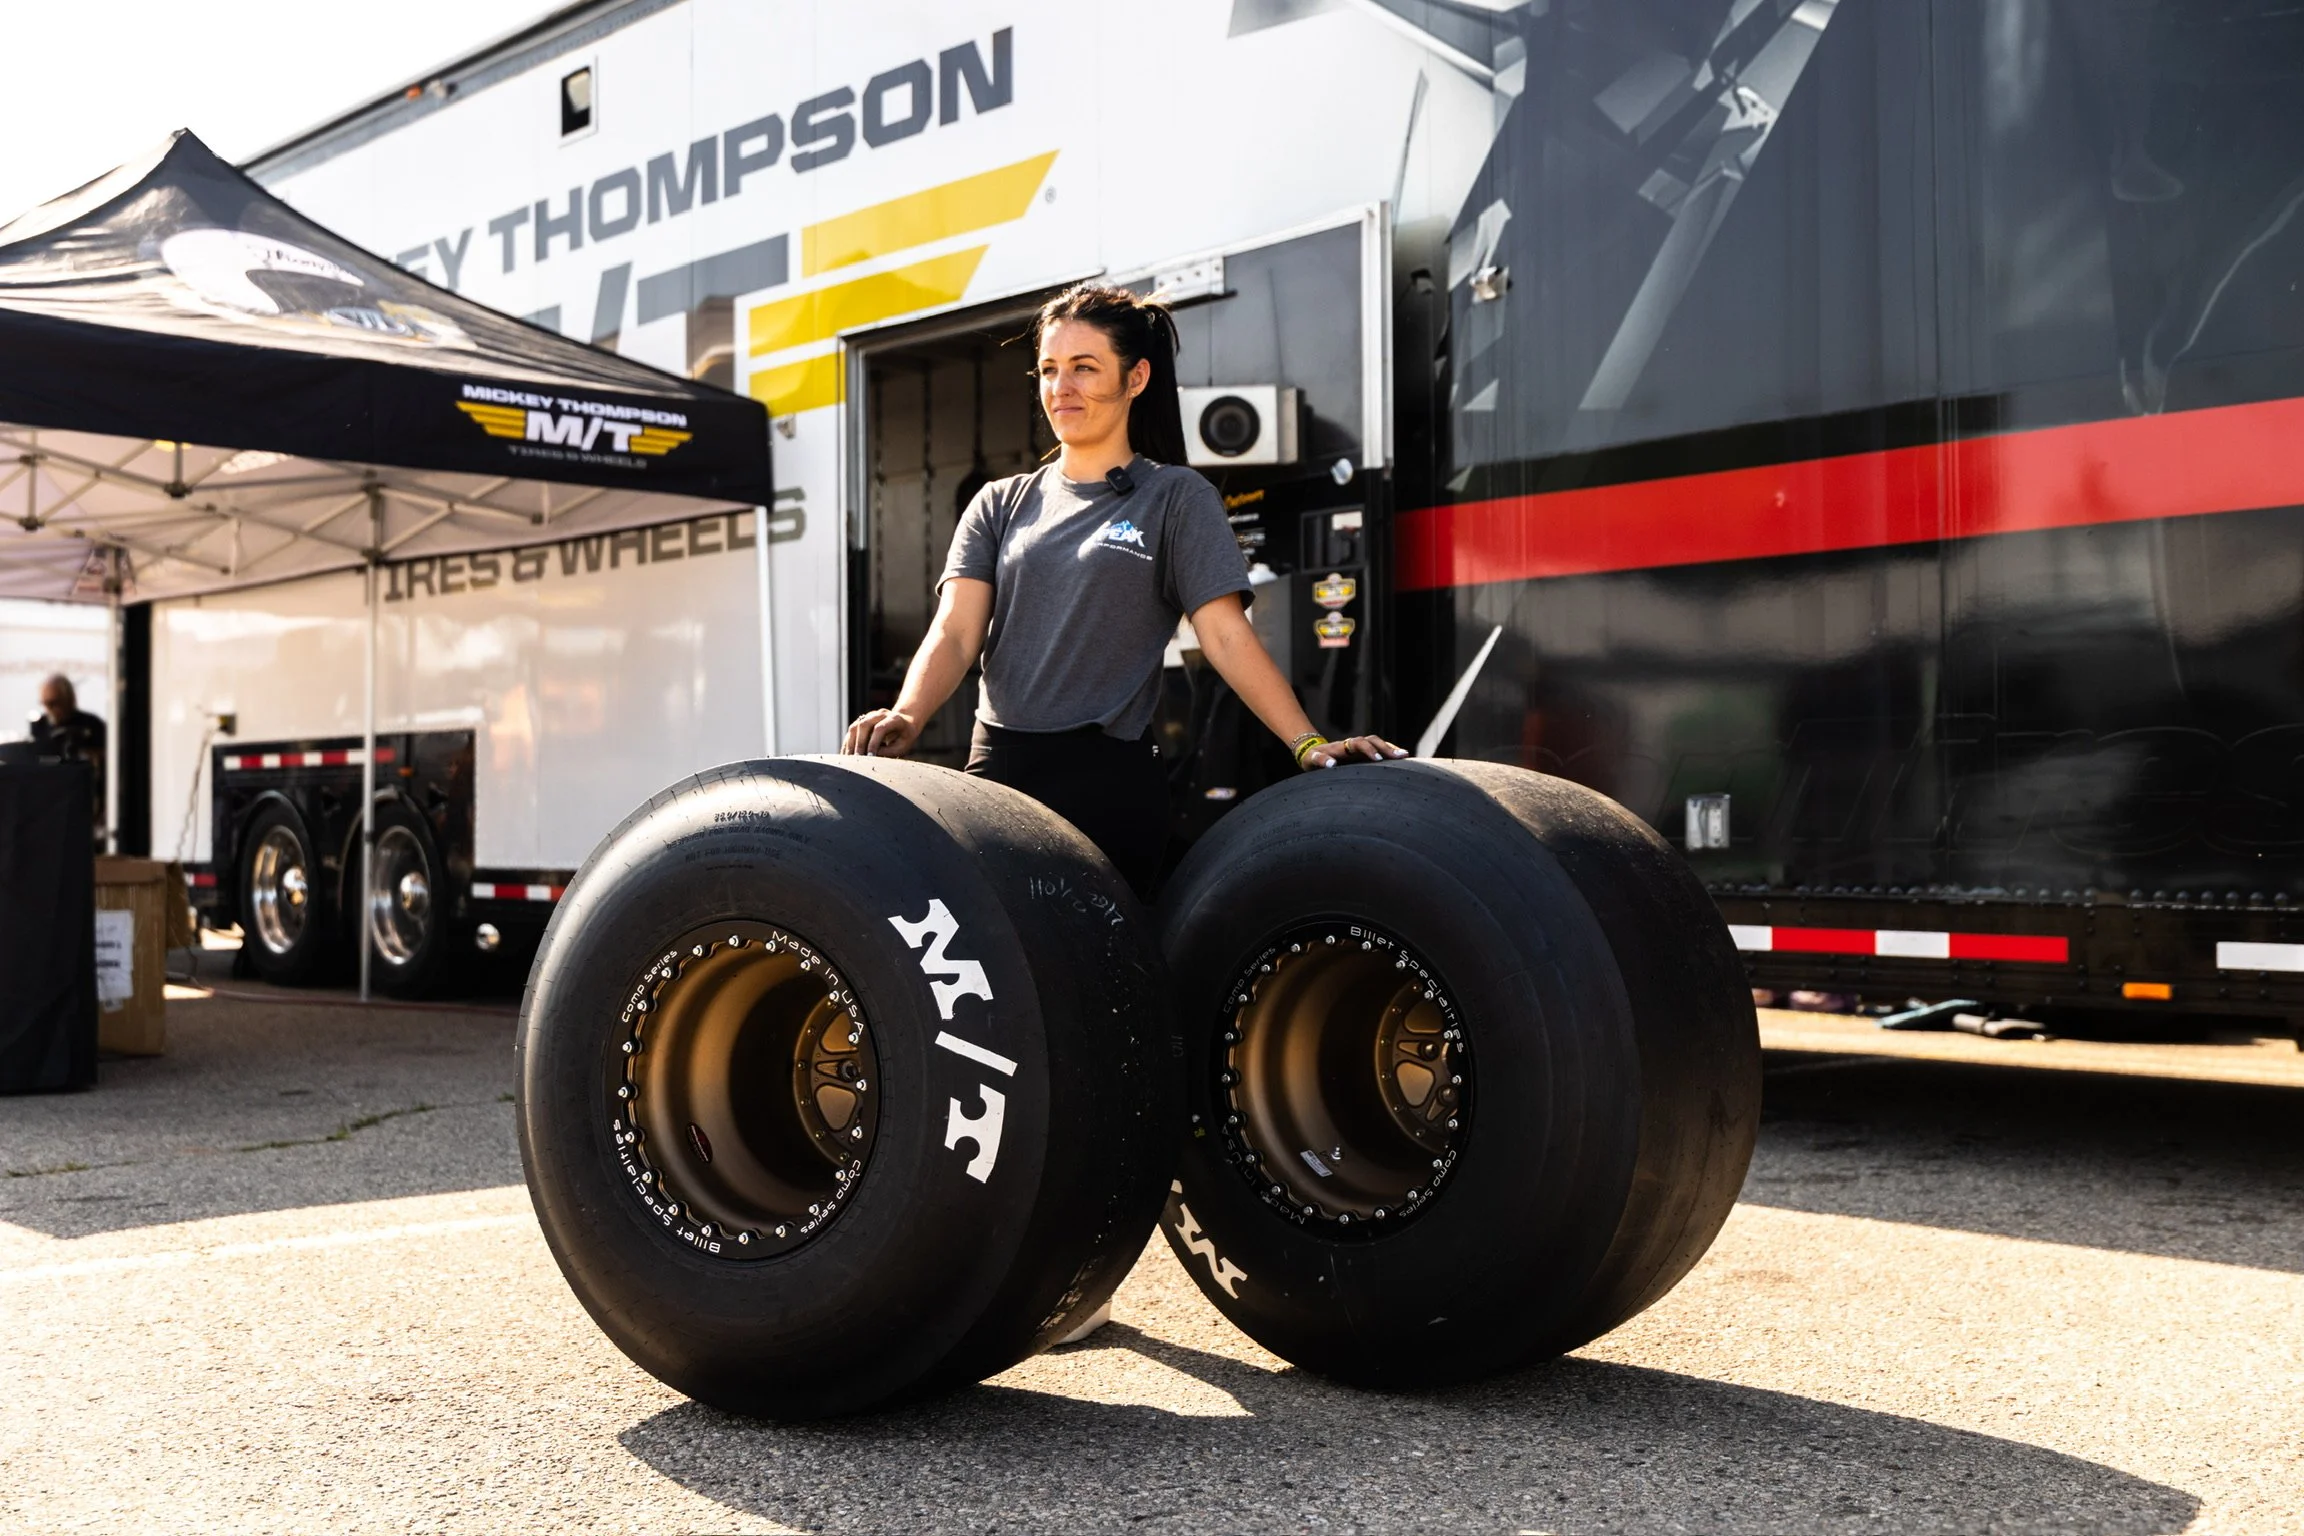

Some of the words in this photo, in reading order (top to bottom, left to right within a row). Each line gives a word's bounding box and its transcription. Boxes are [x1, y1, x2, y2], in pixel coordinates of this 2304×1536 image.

[488, 27, 1014, 275] THOMPSON
[462, 383, 554, 409] MICKEY
[556, 397, 688, 427] THOMPSON
[525, 411, 643, 453] M/T
[511, 548, 550, 582] &
[559, 486, 808, 576] WHEELS
[621, 984, 646, 1024] Comp
[644, 949, 678, 984] Series
[772, 930, 821, 967] Made
[841, 990, 864, 1035] USA
[1223, 978, 1245, 1014] Comp
[1244, 947, 1276, 978] Series
[1350, 925, 1395, 950] Billet
[1399, 949, 1465, 1053] Specialties
[887, 898, 1018, 1185] M/T
[612, 1118, 673, 1226] Specialties
[836, 1158, 861, 1200] Comp
[1432, 1149, 1457, 1188] Comp
[800, 1200, 836, 1234] Series
[1398, 1188, 1434, 1219] Series
[676, 1226, 722, 1254] Billet
